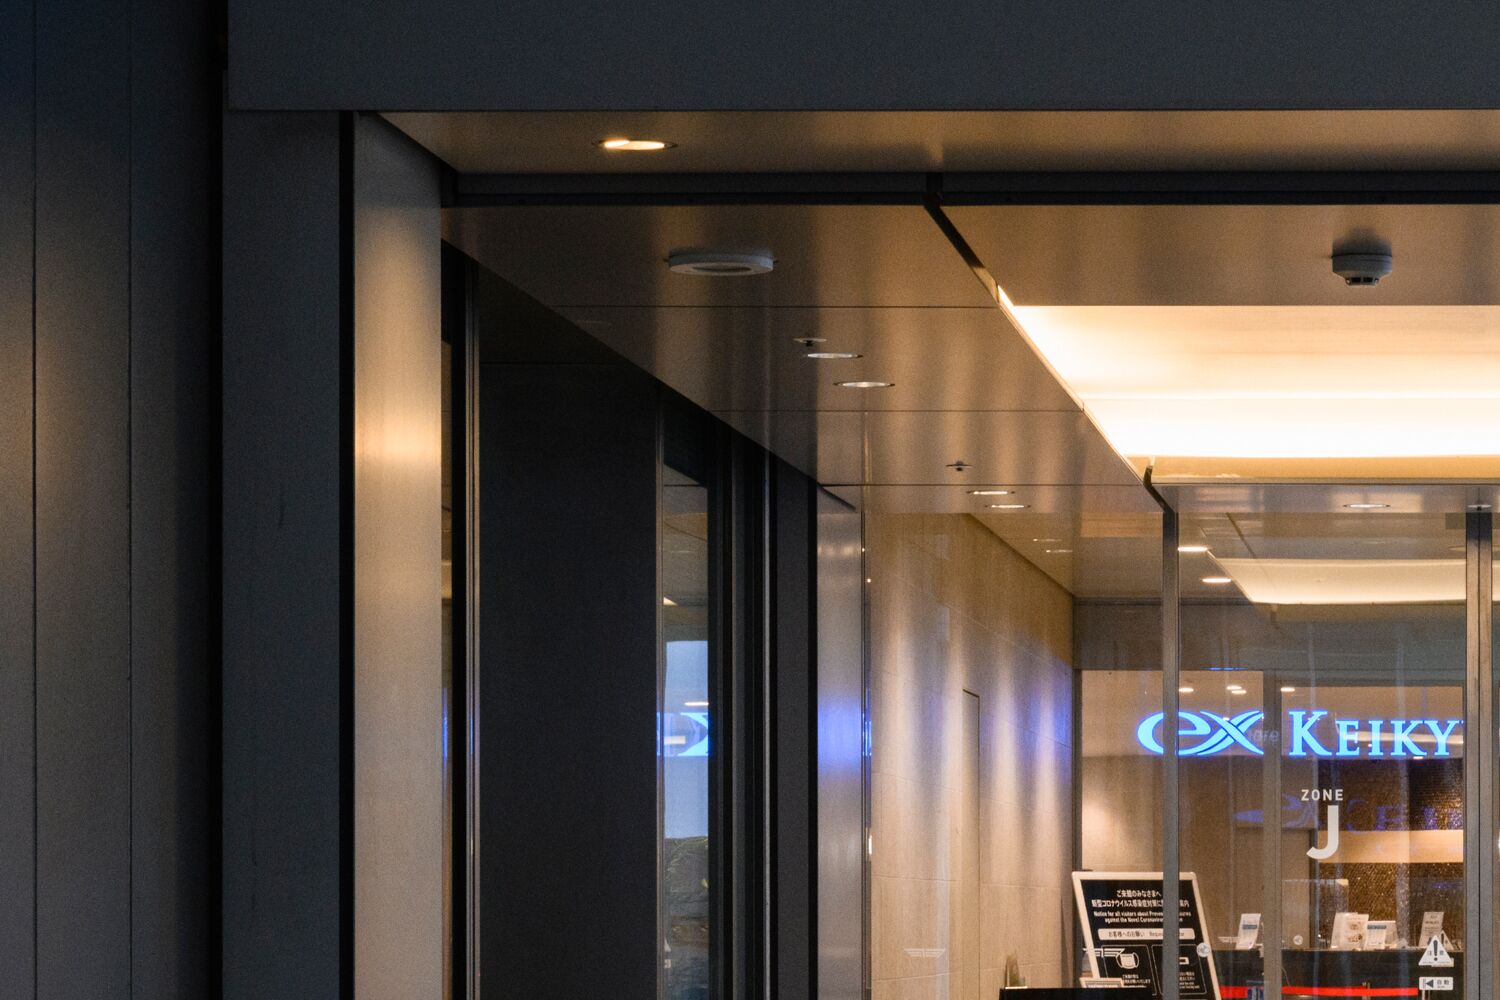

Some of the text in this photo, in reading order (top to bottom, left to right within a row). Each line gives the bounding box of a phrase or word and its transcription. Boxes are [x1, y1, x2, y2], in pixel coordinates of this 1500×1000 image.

[1288, 711, 1464, 756] KEIKY
[1301, 789, 1343, 801] ZONE
[1306, 805, 1339, 860] J
